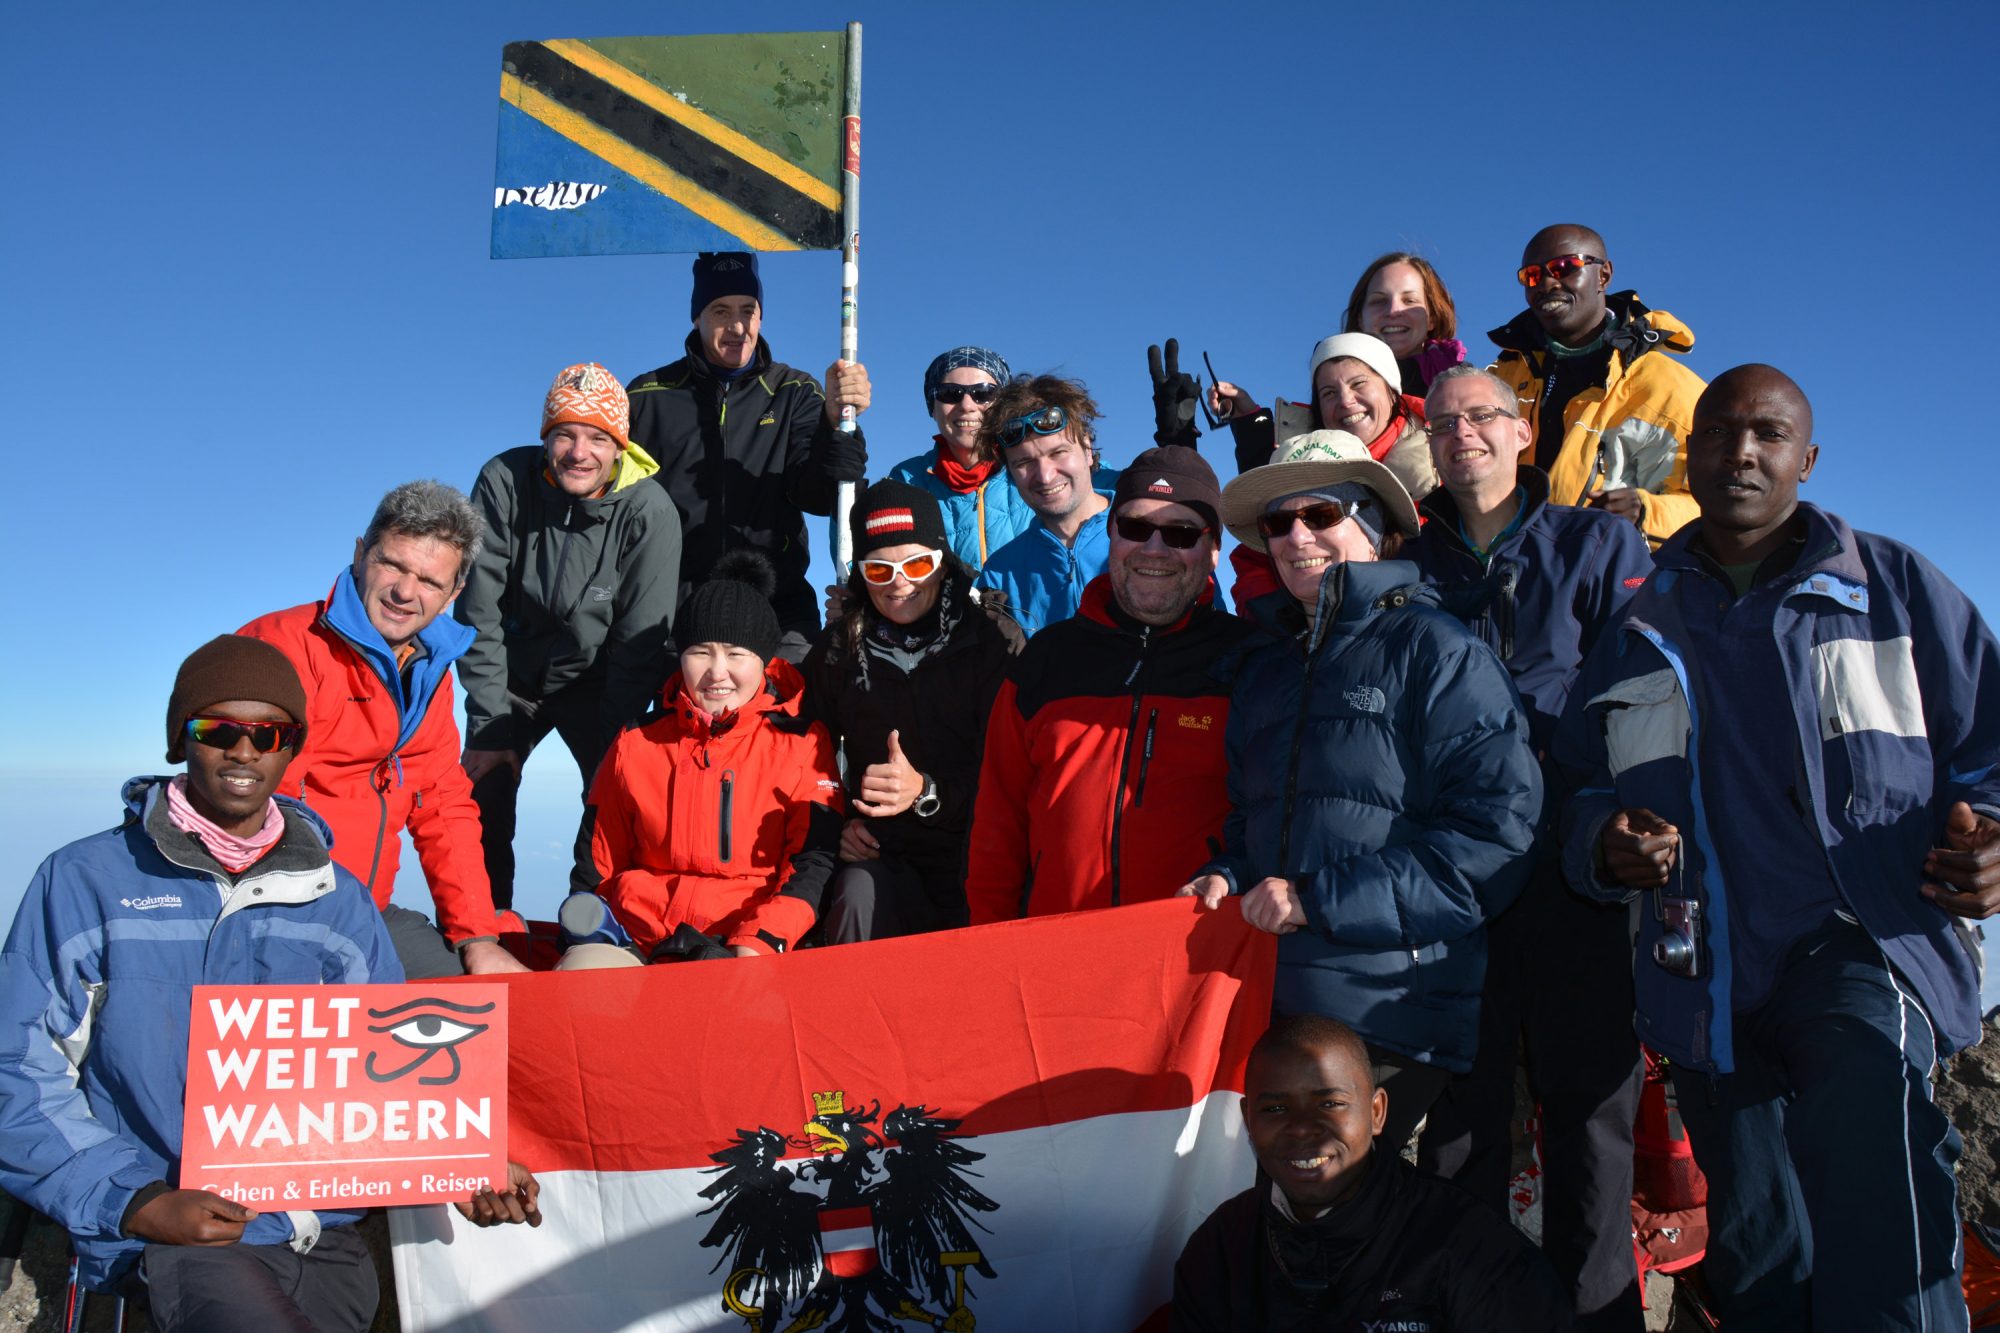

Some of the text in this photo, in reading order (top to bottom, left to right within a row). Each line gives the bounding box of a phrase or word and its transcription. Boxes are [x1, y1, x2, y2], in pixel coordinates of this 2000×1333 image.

[1342, 689, 1371, 704] NORTH
[1357, 685, 1372, 695] THE
[1350, 700, 1370, 711] FACE
[132, 894, 182, 906] Columbia
[208, 997, 361, 1042] WELT
[206, 1047, 359, 1093] WEIT
[202, 1096, 491, 1150] WANDERN
[282, 1180, 301, 1200] &
[309, 1178, 392, 1199] Erleben
[421, 1172, 490, 1193] Reisen
